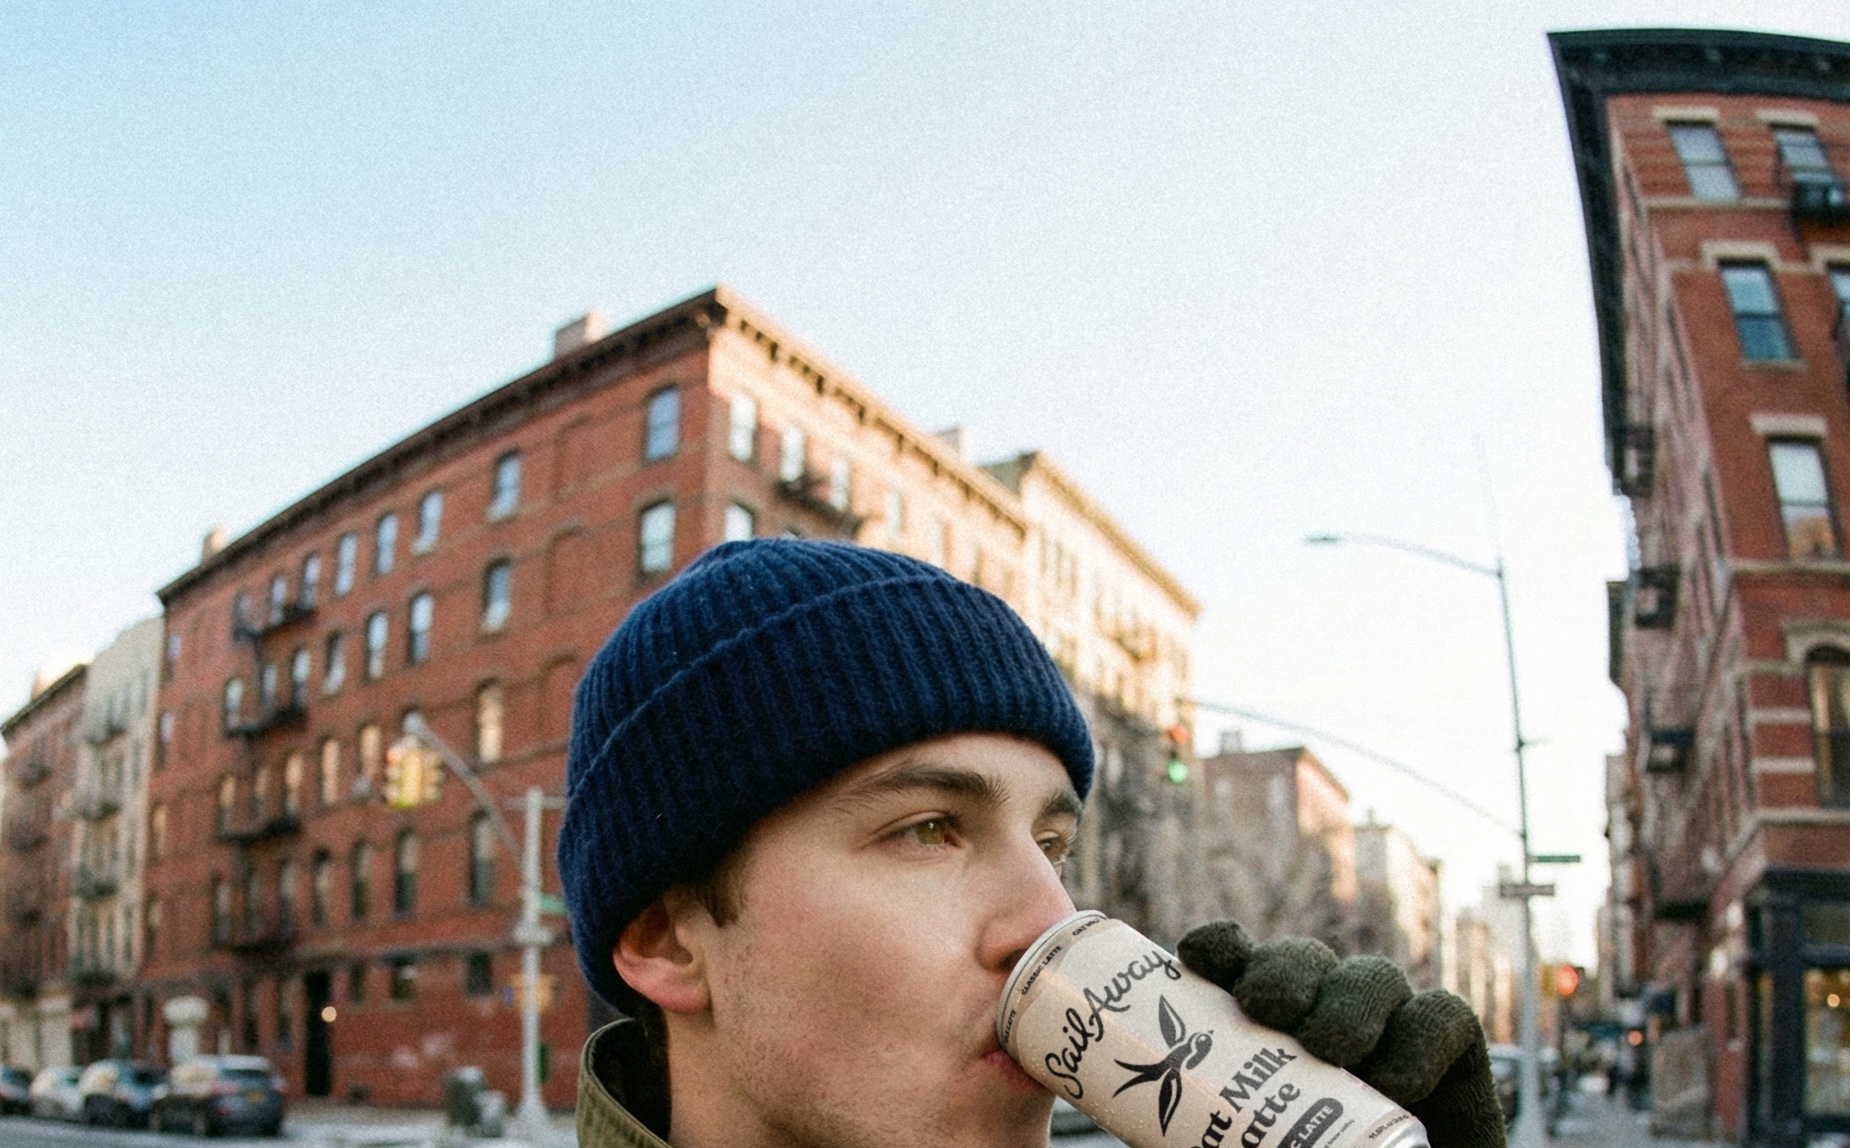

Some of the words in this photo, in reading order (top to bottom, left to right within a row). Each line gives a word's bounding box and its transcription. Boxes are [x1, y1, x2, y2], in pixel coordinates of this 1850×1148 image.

[1021, 964, 1044, 996] CLASSIC
[1042, 945, 1063, 966] LATTE
[1045, 1008, 1095, 1099] Sail
[1083, 950, 1182, 1042] Away
[1219, 1048, 1297, 1113] Milk
[1298, 1105, 1334, 1140] LATTE
